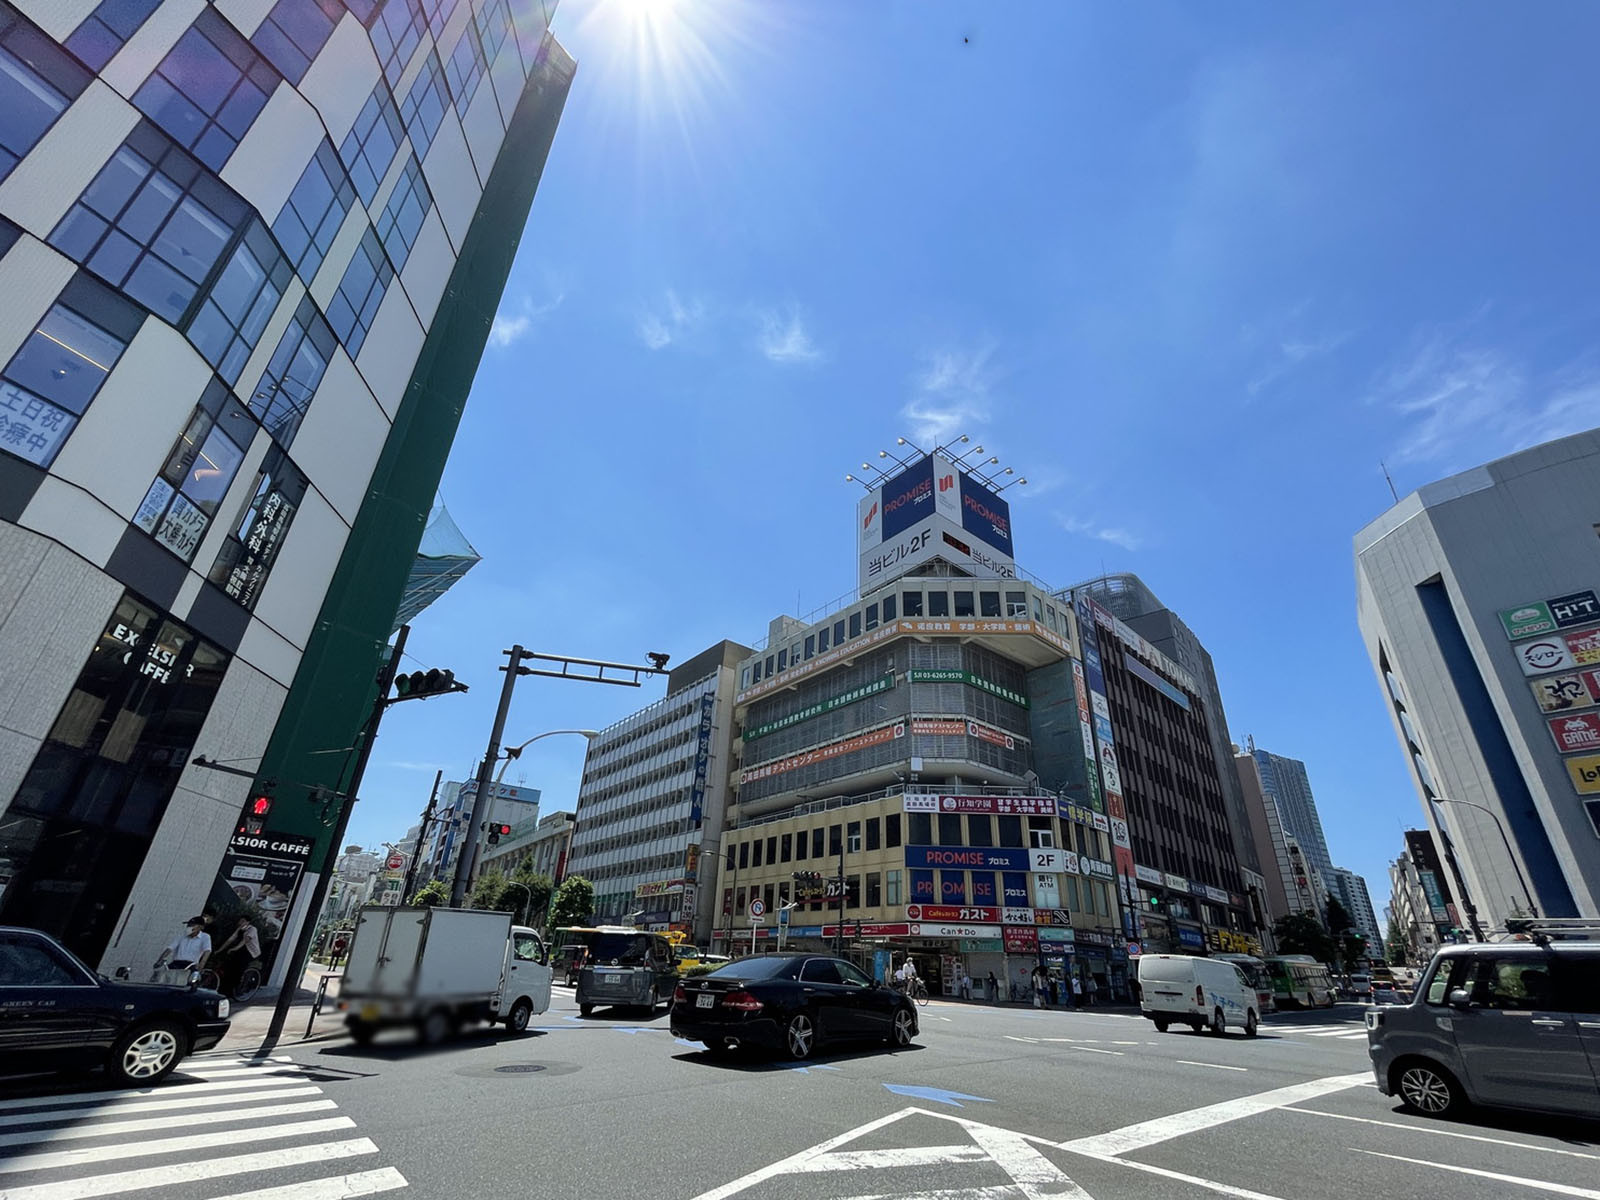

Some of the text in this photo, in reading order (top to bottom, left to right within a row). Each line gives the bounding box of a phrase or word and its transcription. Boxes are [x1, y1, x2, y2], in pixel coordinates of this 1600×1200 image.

[0, 390, 66, 432] 土日祝
[884, 477, 931, 515] PROMISE
[914, 490, 932, 506] プロミス
[964, 494, 1008, 532] PROMISE
[992, 524, 1009, 540] プロミス
[1524, 650, 1564, 663] スシロー
[1562, 728, 1600, 744] GAME
[958, 799, 992, 809] 行知学園
[271, 841, 310, 855] CAFFÉ
[926, 851, 1010, 866] PROMISE プロミス
[1037, 854, 1055, 867] 2F
[1005, 888, 1027, 897] プロミス
[959, 909, 989, 920] ガスト
[940, 927, 956, 935] Can
